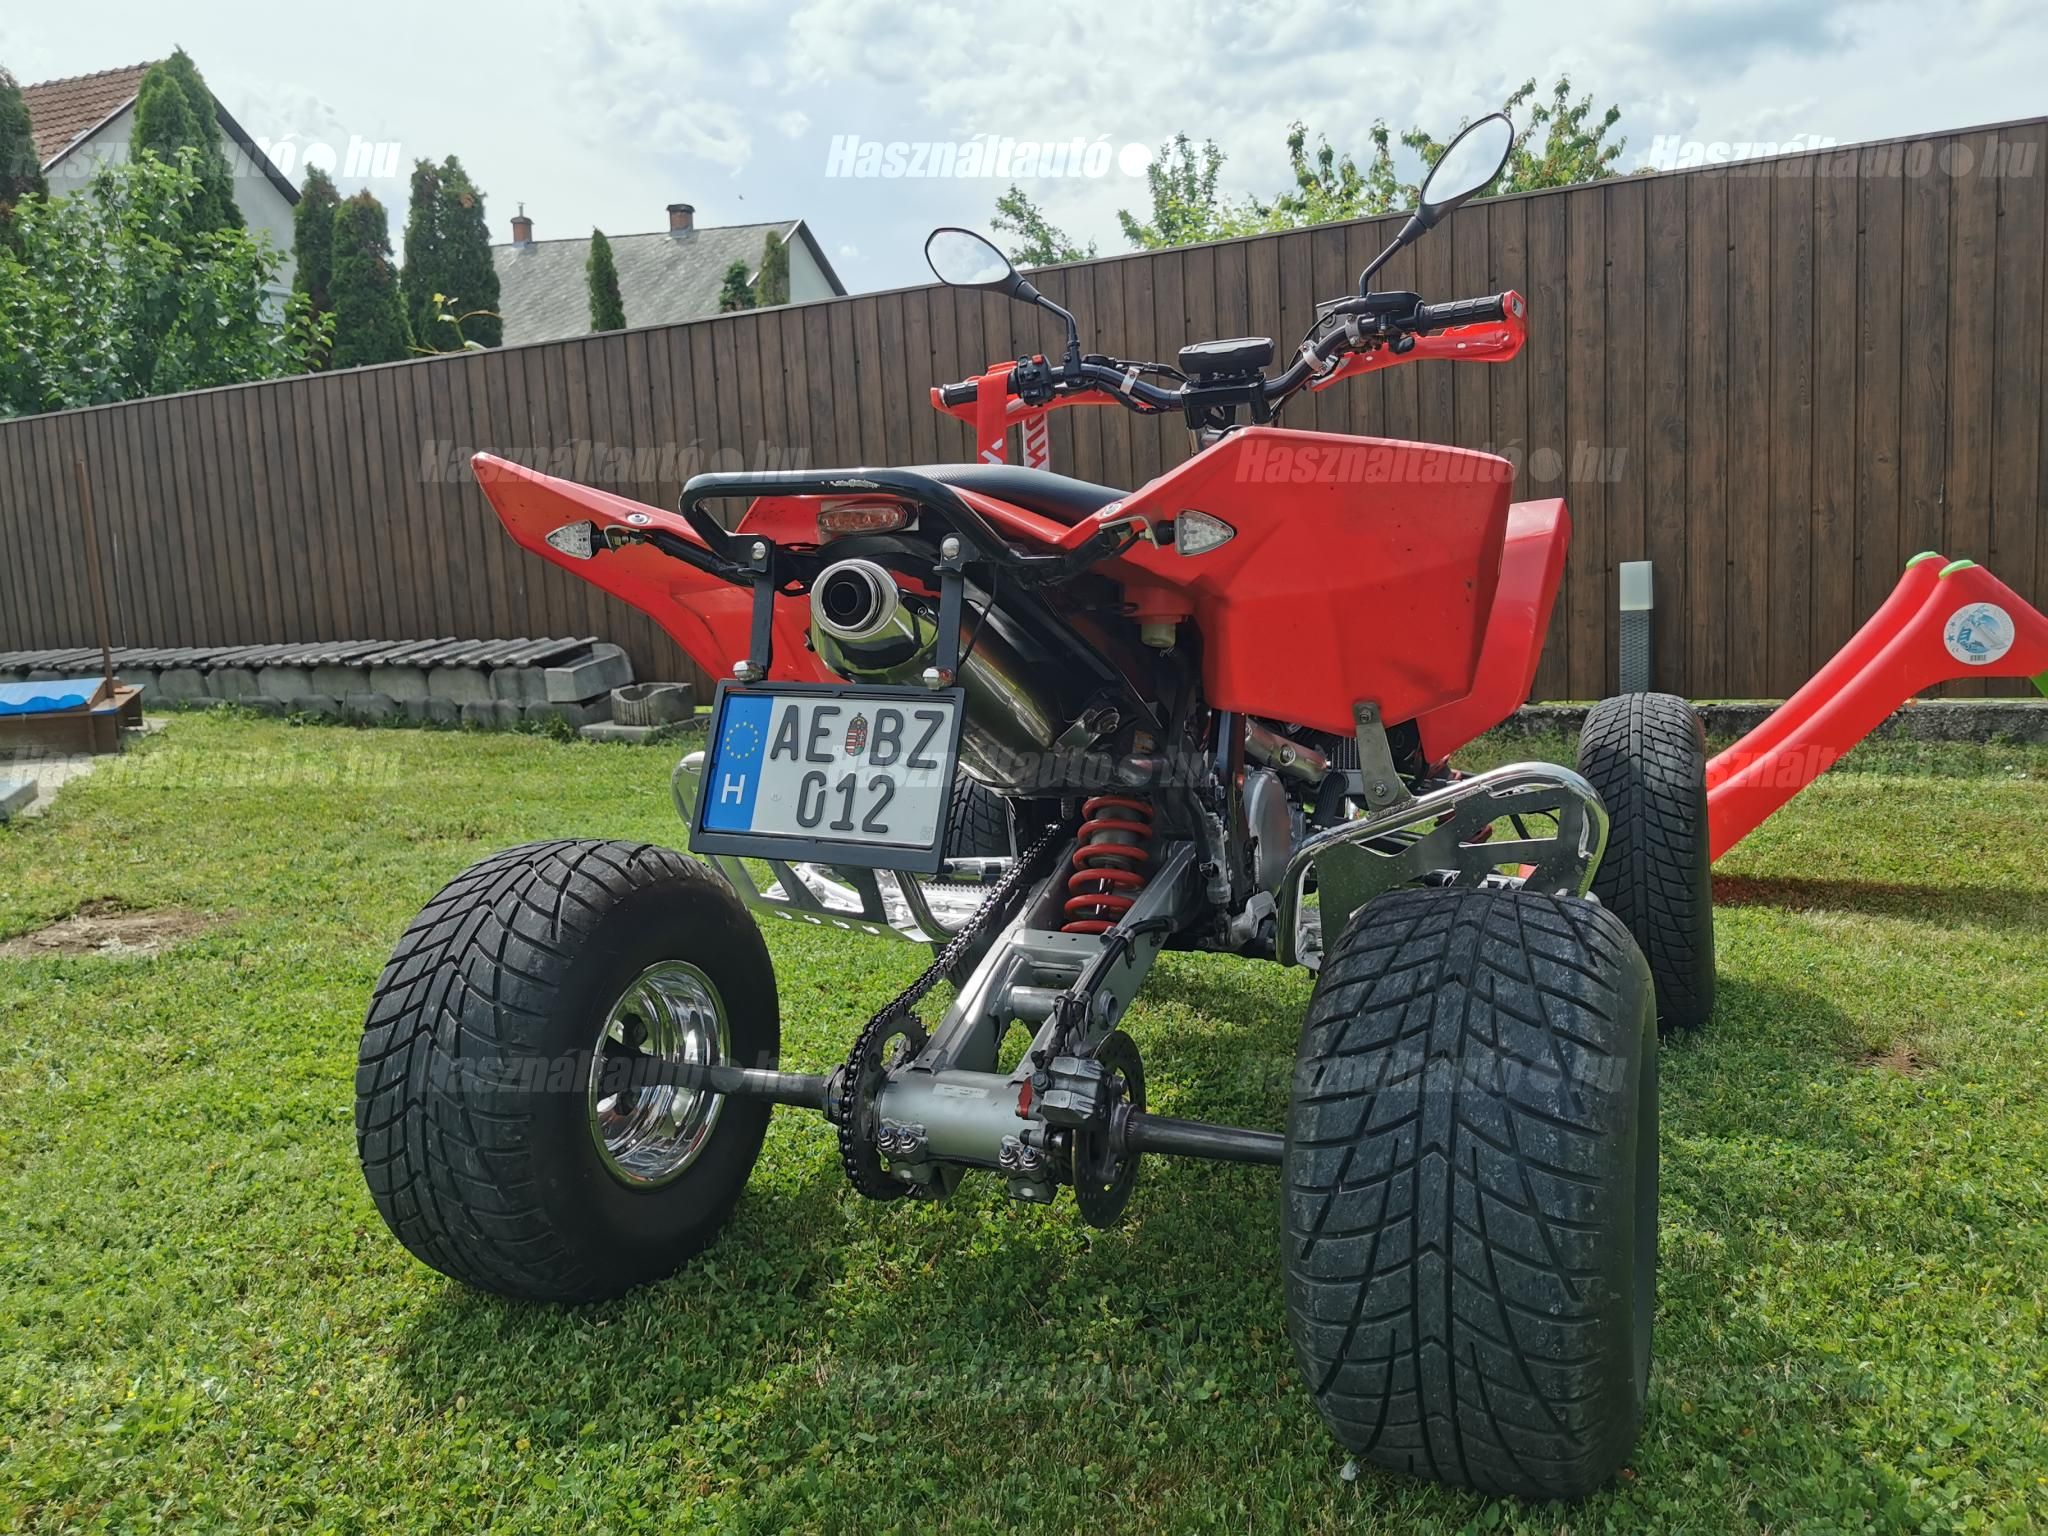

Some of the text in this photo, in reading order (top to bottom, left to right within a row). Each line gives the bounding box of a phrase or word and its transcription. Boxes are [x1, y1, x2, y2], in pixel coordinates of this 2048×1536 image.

[770, 705, 945, 769] AE BZ
[720, 773, 746, 805] H
[796, 770, 895, 833] 012
